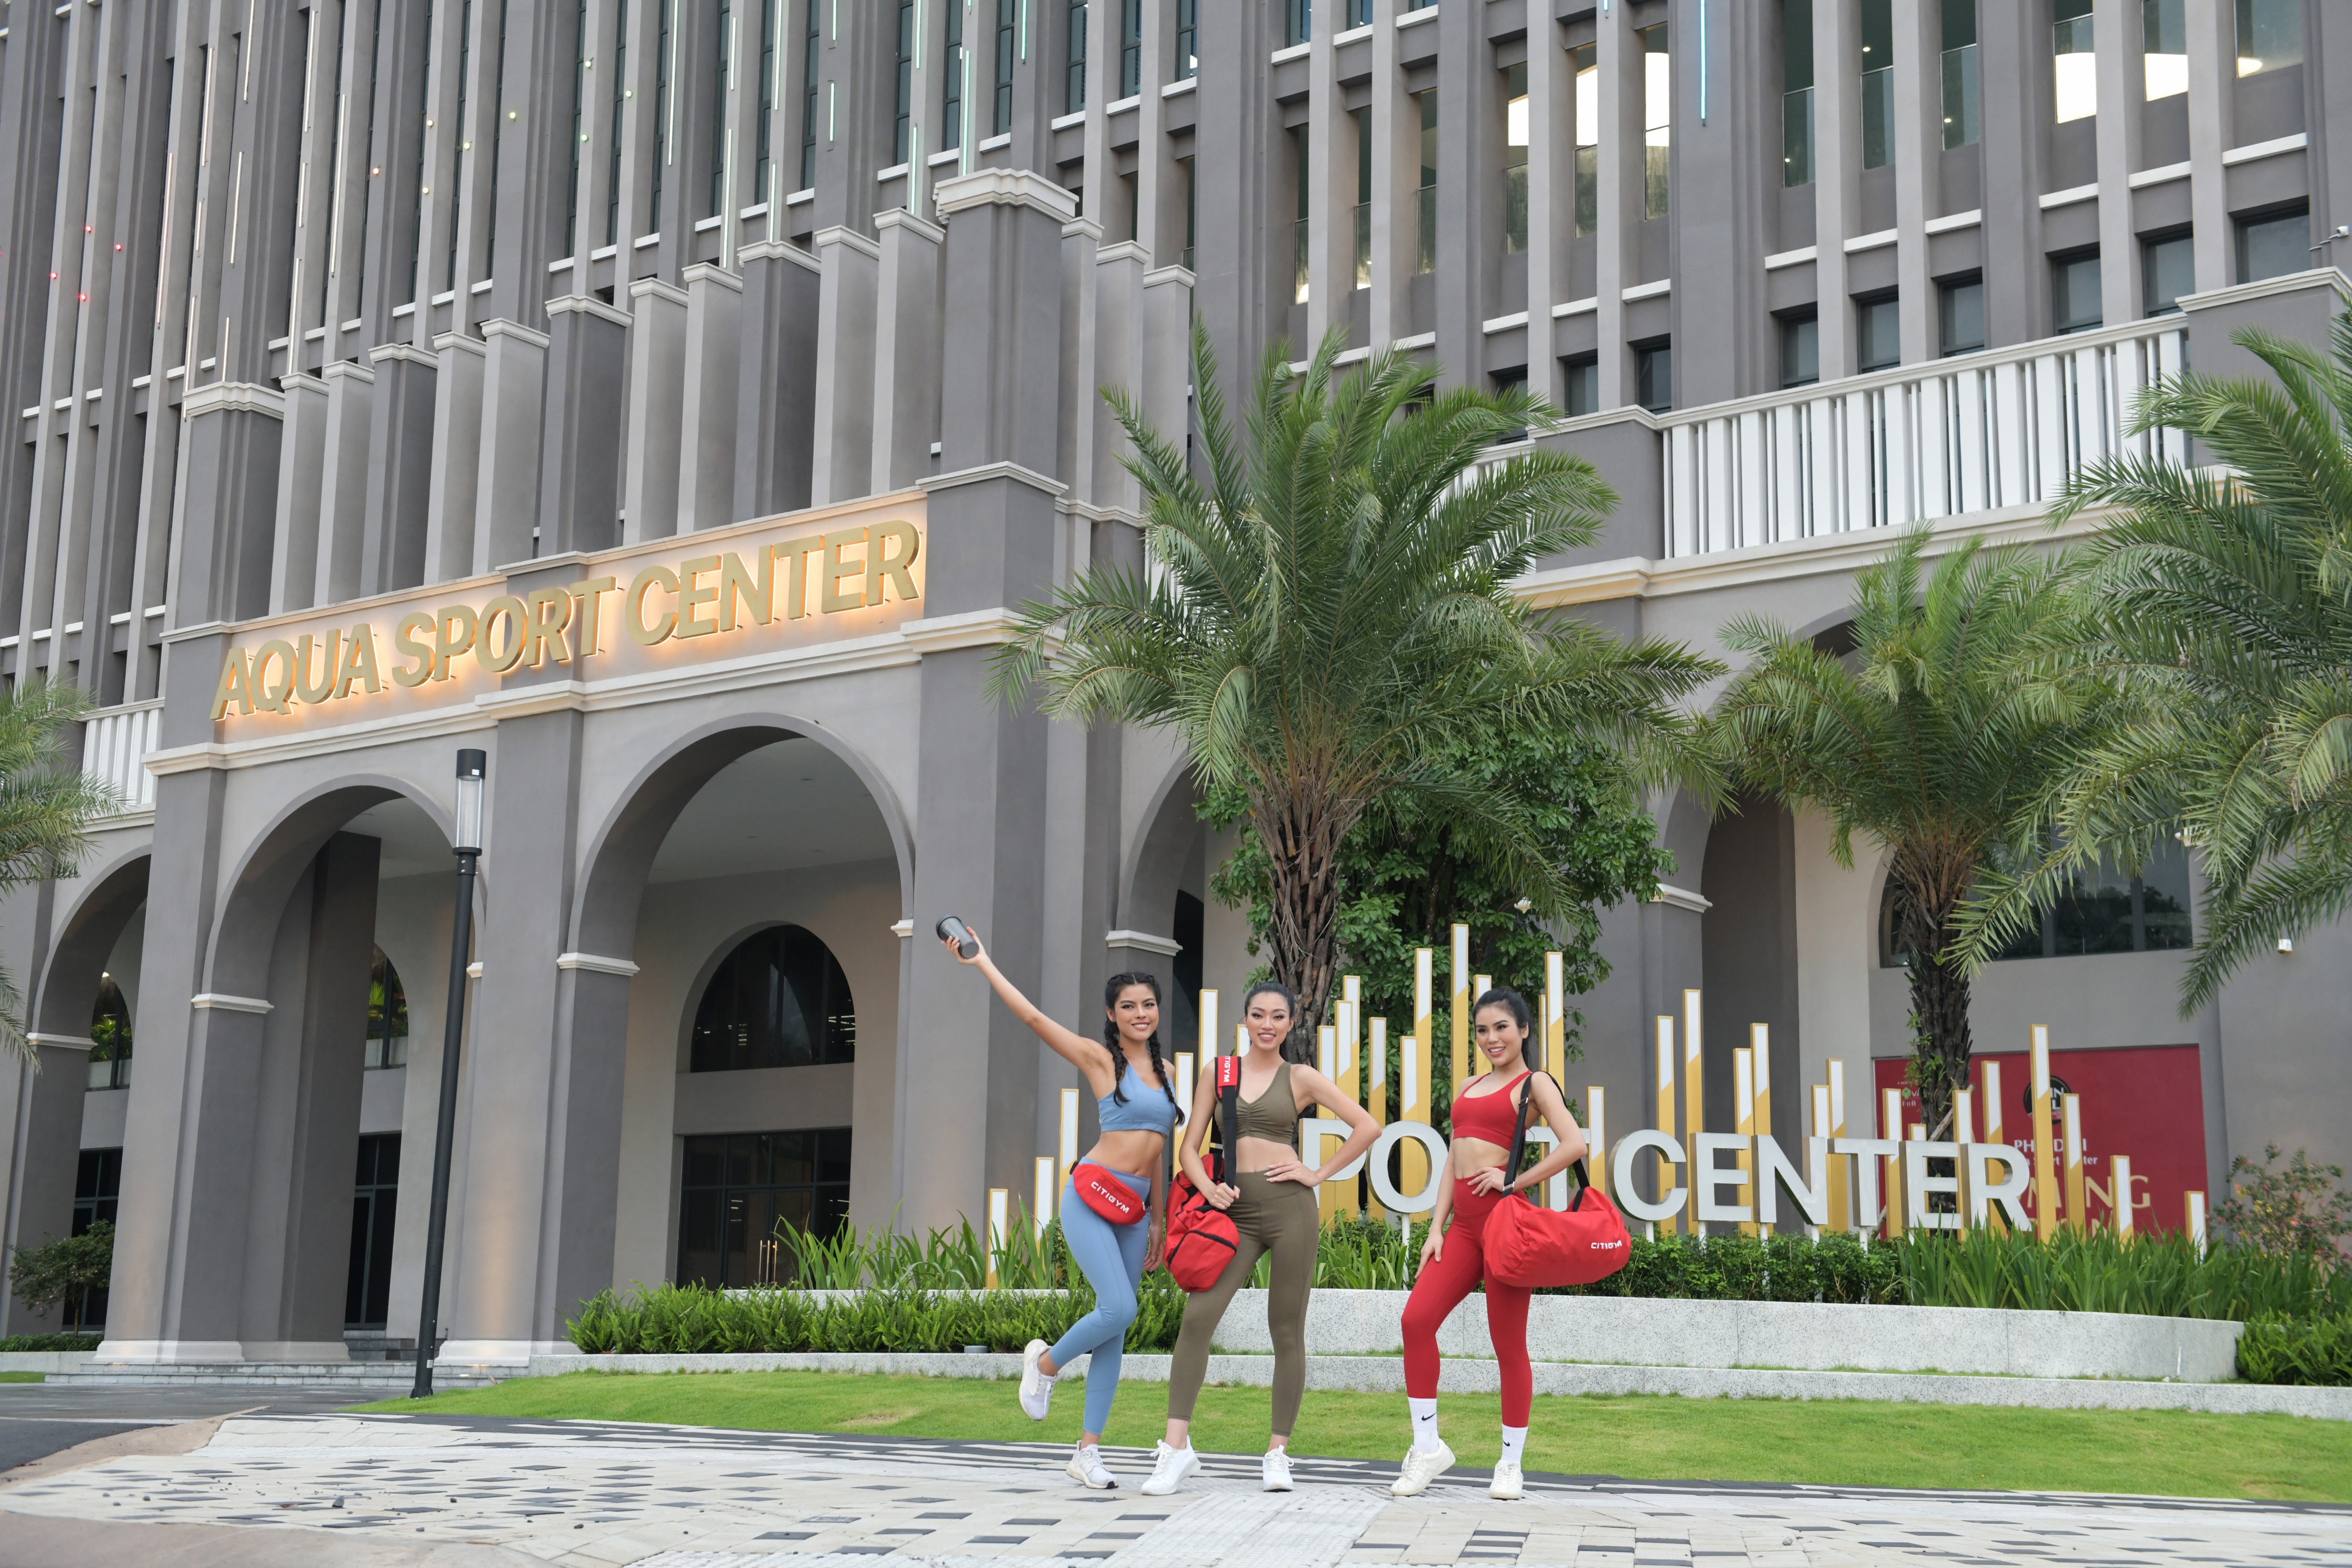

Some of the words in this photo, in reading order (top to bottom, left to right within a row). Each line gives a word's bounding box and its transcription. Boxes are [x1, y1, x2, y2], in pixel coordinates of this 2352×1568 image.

[209, 622, 383, 721] AQUA
[392, 576, 617, 688] SPORT
[625, 519, 922, 646] CENTER
[1090, 1181, 1130, 1214] CITIGYM
[1608, 1128, 2032, 1232] CENTER
[1591, 1240, 1622, 1249] CITIGYM
